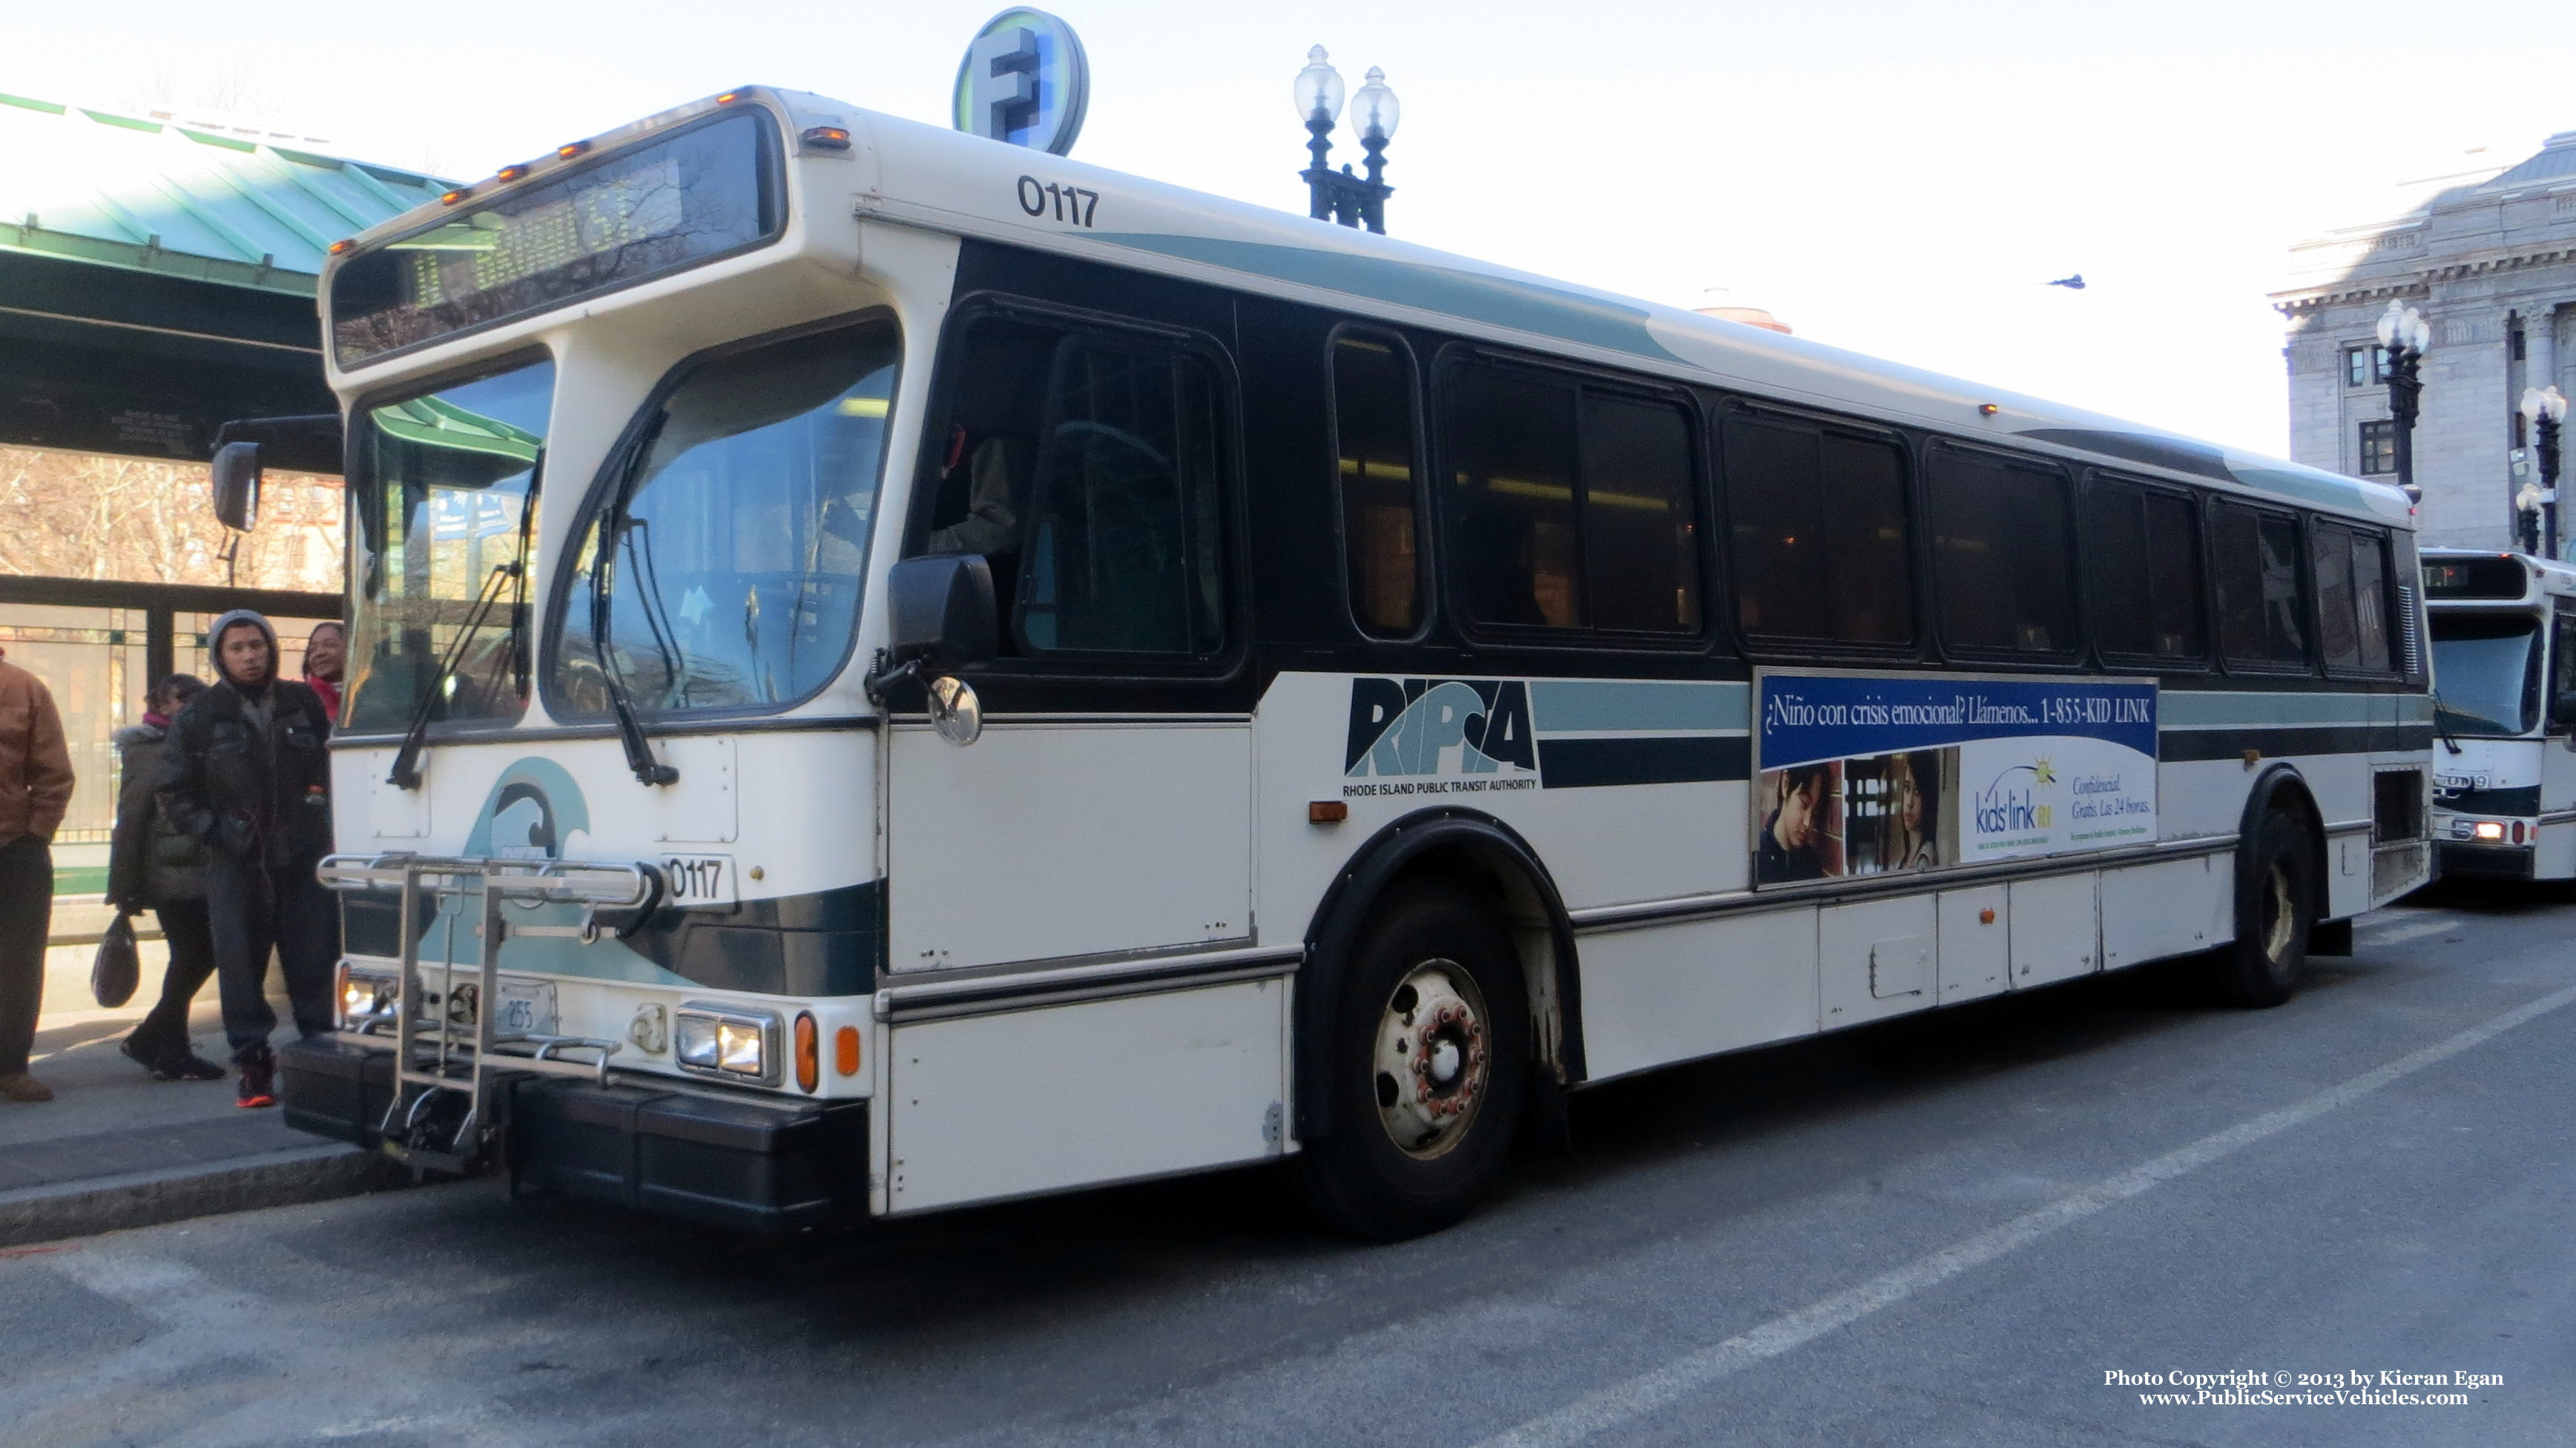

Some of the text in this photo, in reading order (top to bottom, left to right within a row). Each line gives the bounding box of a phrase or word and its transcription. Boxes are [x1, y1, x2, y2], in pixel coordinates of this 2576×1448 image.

[971, 27, 1034, 141] F
[1018, 174, 1099, 228] 0117
[1766, 694, 2150, 735] ¿Niño con crisis emocional? Llámenos... 1-855-KID LINK
[1343, 778, 1537, 797] RHODE ISLAND PUBLIC TRANSIT AUTHORITY
[670, 858, 722, 898] 0117
